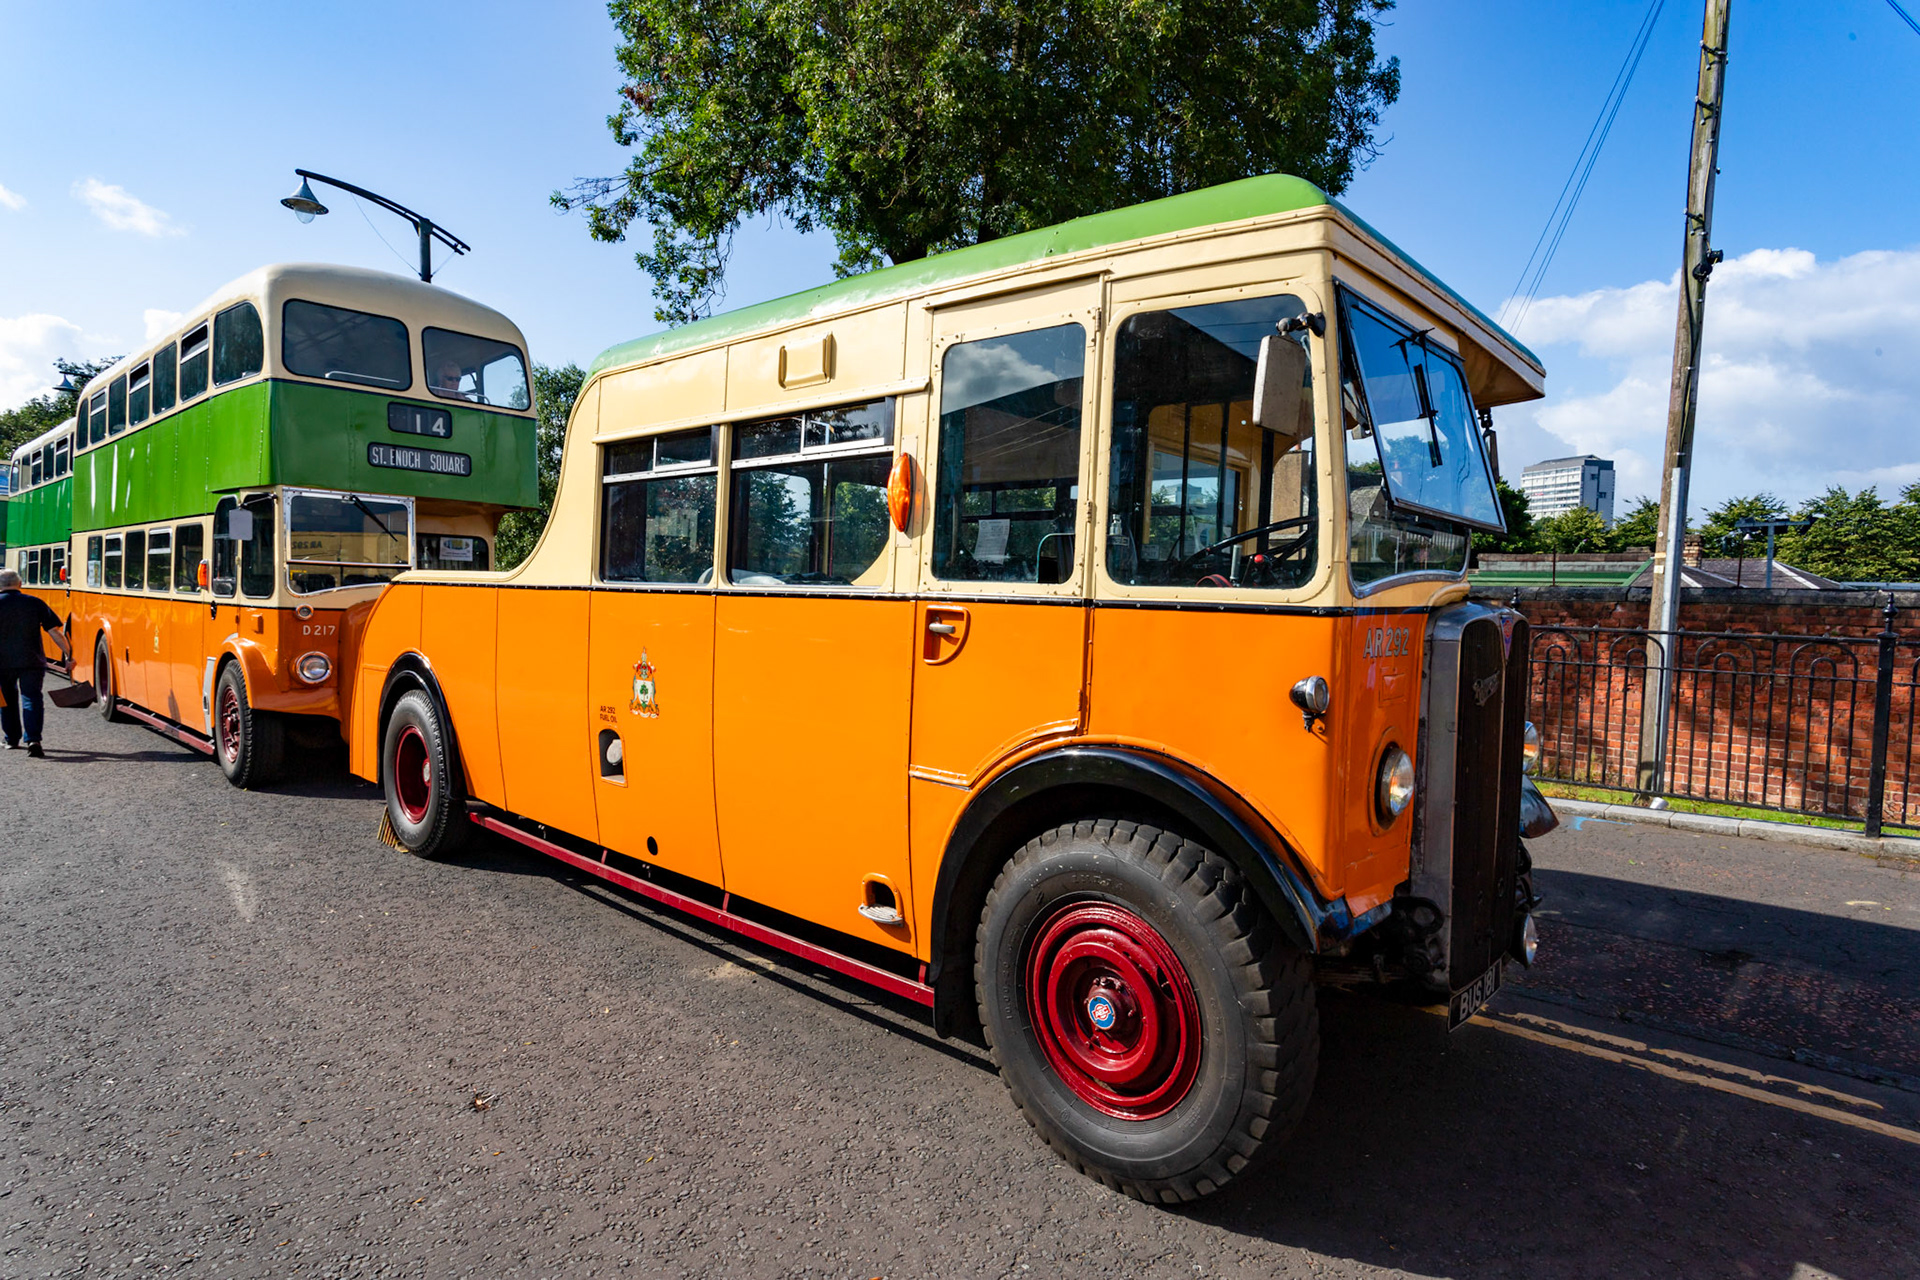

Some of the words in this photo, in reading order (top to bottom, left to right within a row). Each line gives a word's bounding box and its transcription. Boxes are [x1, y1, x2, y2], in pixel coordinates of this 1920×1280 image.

[415, 413, 446, 436] 14
[390, 448, 420, 468] ENOCH
[430, 454, 466, 474] SQUARE
[1459, 979, 1482, 1021] BUS
